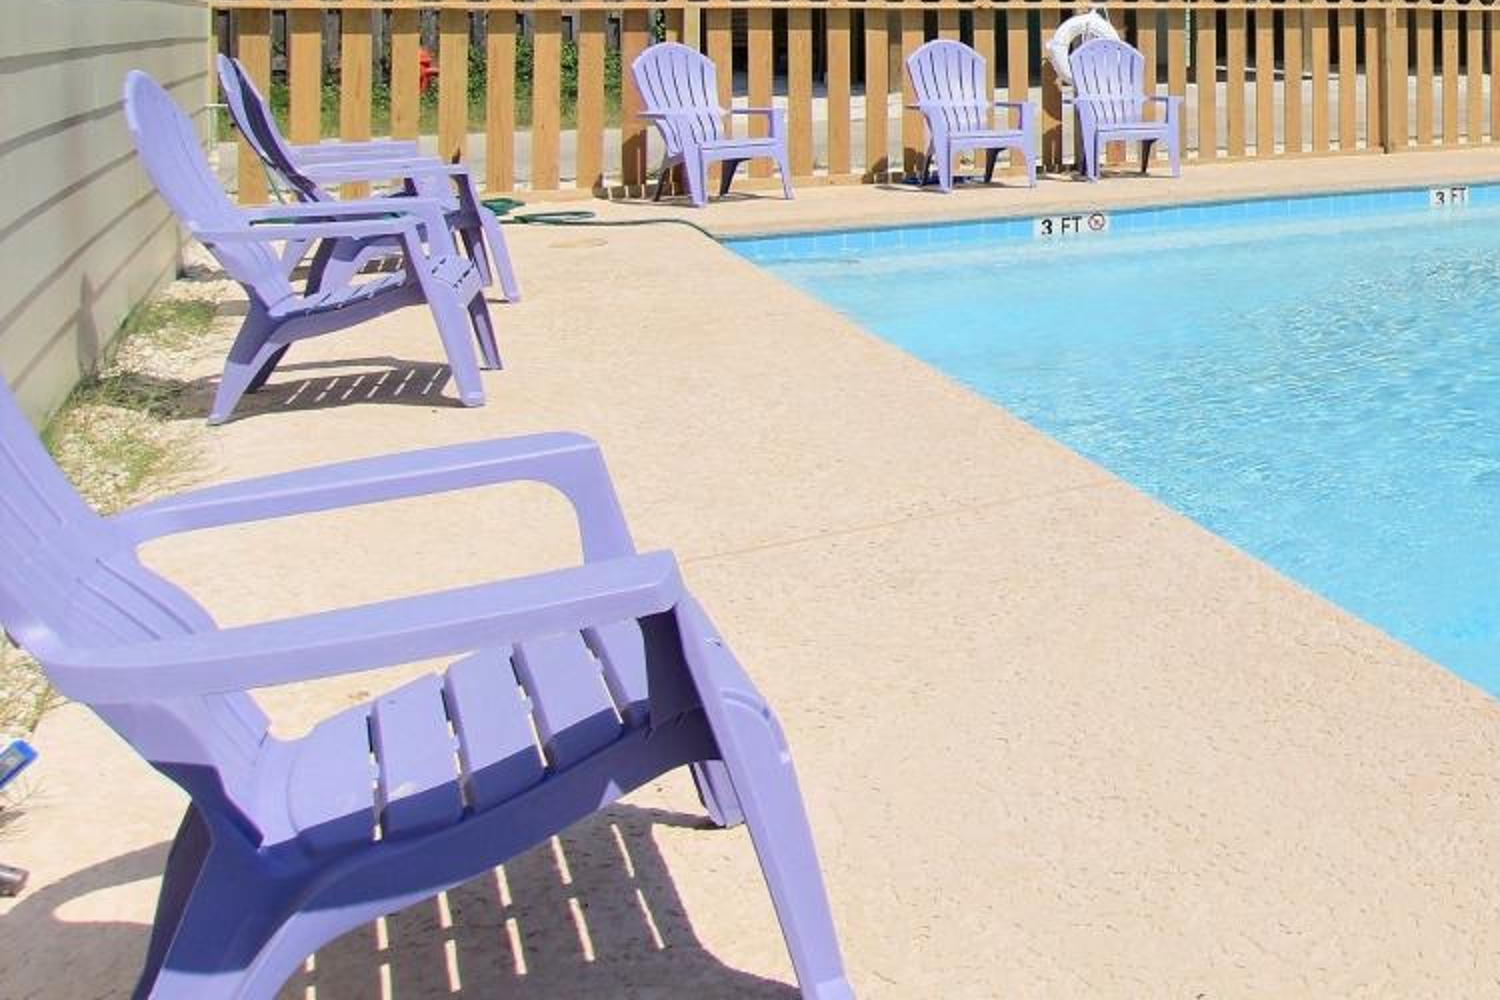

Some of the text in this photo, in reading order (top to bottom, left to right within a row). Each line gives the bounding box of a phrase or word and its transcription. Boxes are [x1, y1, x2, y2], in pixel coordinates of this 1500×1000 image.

[1435, 187, 1467, 206] 3 FT
[1041, 216, 1082, 235] 3 FT
